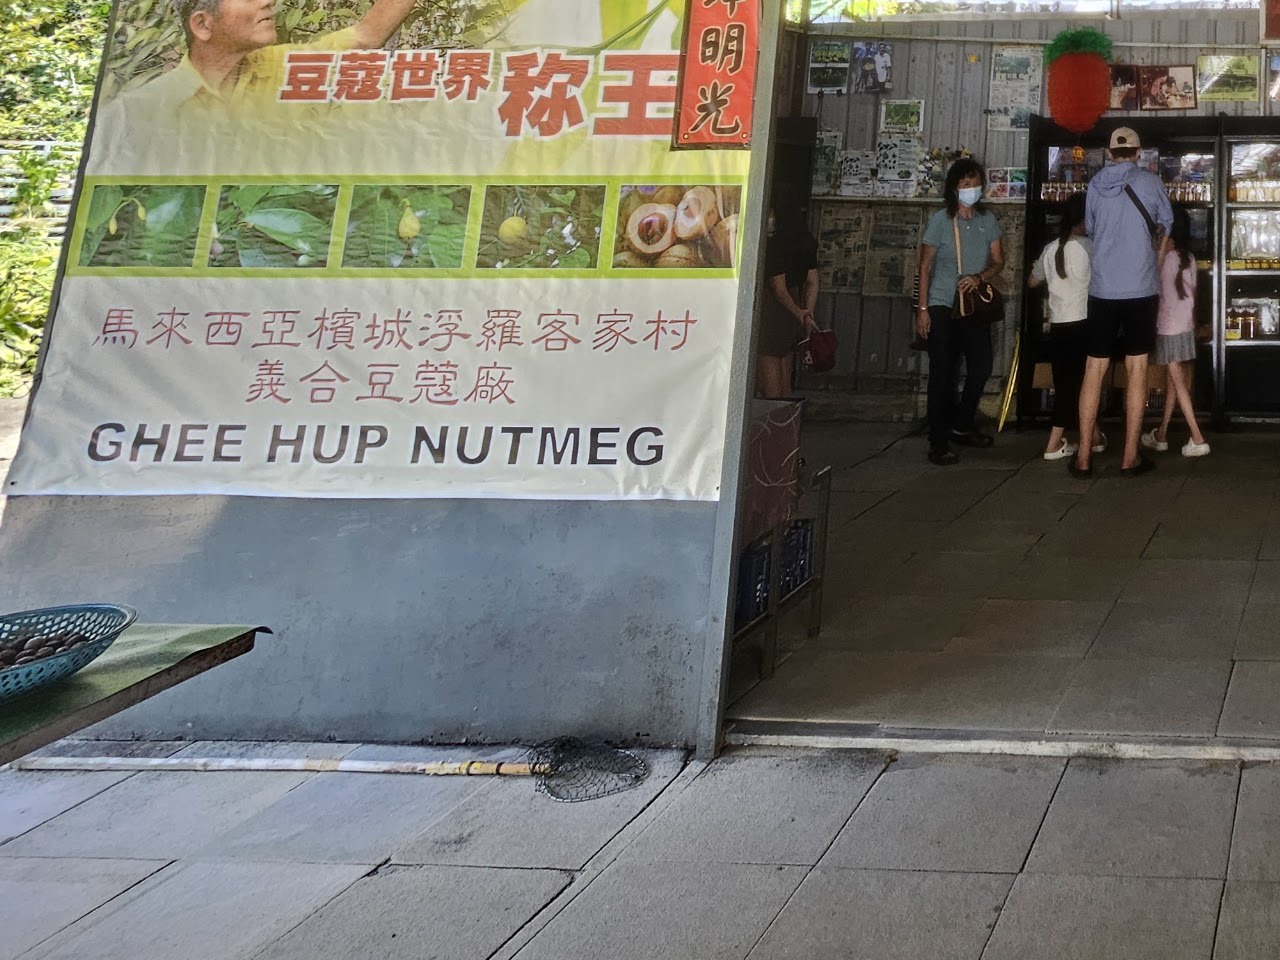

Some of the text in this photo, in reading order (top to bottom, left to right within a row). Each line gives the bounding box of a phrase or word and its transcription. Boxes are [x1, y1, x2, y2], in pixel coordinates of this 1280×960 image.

[279, 50, 682, 137] 豆蔻世界 称王
[91, 307, 698, 352] 馬來西亞檳城浮羅客家村
[245, 360, 516, 406] 義合豆蔻廠
[86, 422, 666, 467] GHEE HUP NUTMEG
